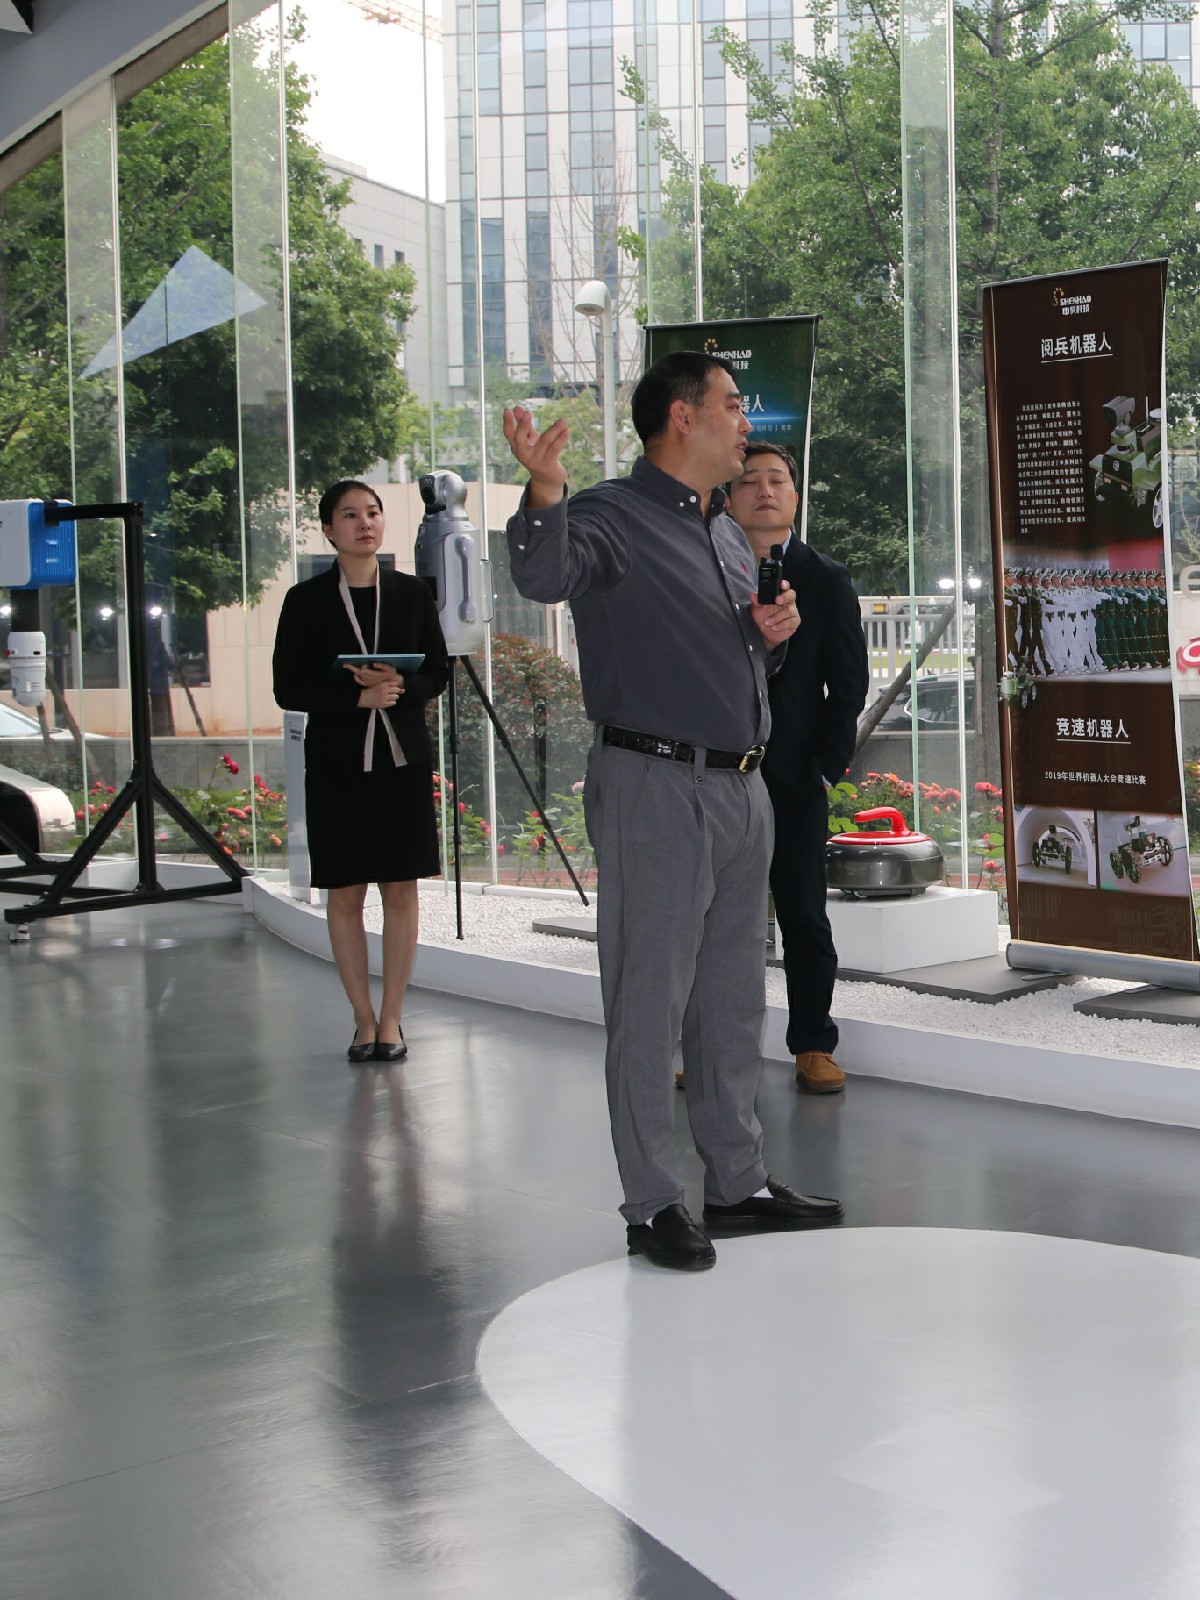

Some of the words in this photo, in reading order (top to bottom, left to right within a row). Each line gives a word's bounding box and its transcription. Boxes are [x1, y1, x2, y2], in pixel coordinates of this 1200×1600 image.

[1041, 332, 1111, 358] 阅兵机器人
[741, 394, 764, 413] 器人
[1056, 718, 1129, 738] 竞速机器人
[1044, 771, 1147, 785] 2019年世界机器人大会竞速比赛
